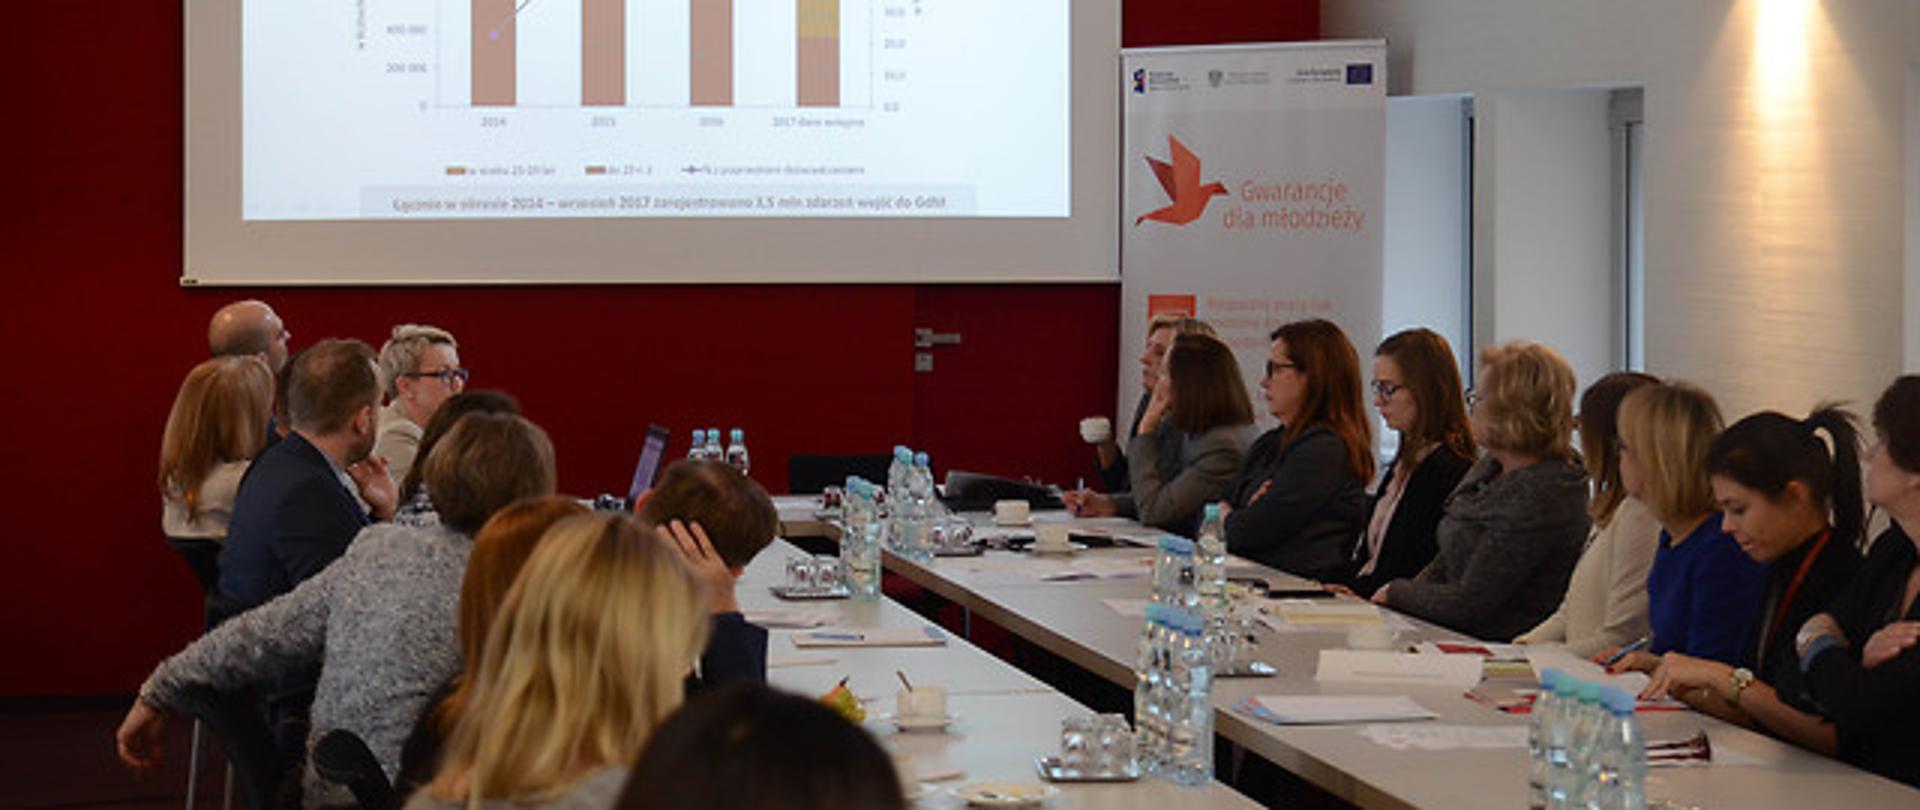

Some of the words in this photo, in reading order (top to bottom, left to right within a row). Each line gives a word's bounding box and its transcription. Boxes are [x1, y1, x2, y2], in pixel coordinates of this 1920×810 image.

[511, 196, 544, 210] 2014
[1240, 177, 1346, 208] Gwarancje
[1223, 205, 1256, 230] dla
[1261, 205, 1366, 232] młodzieży
